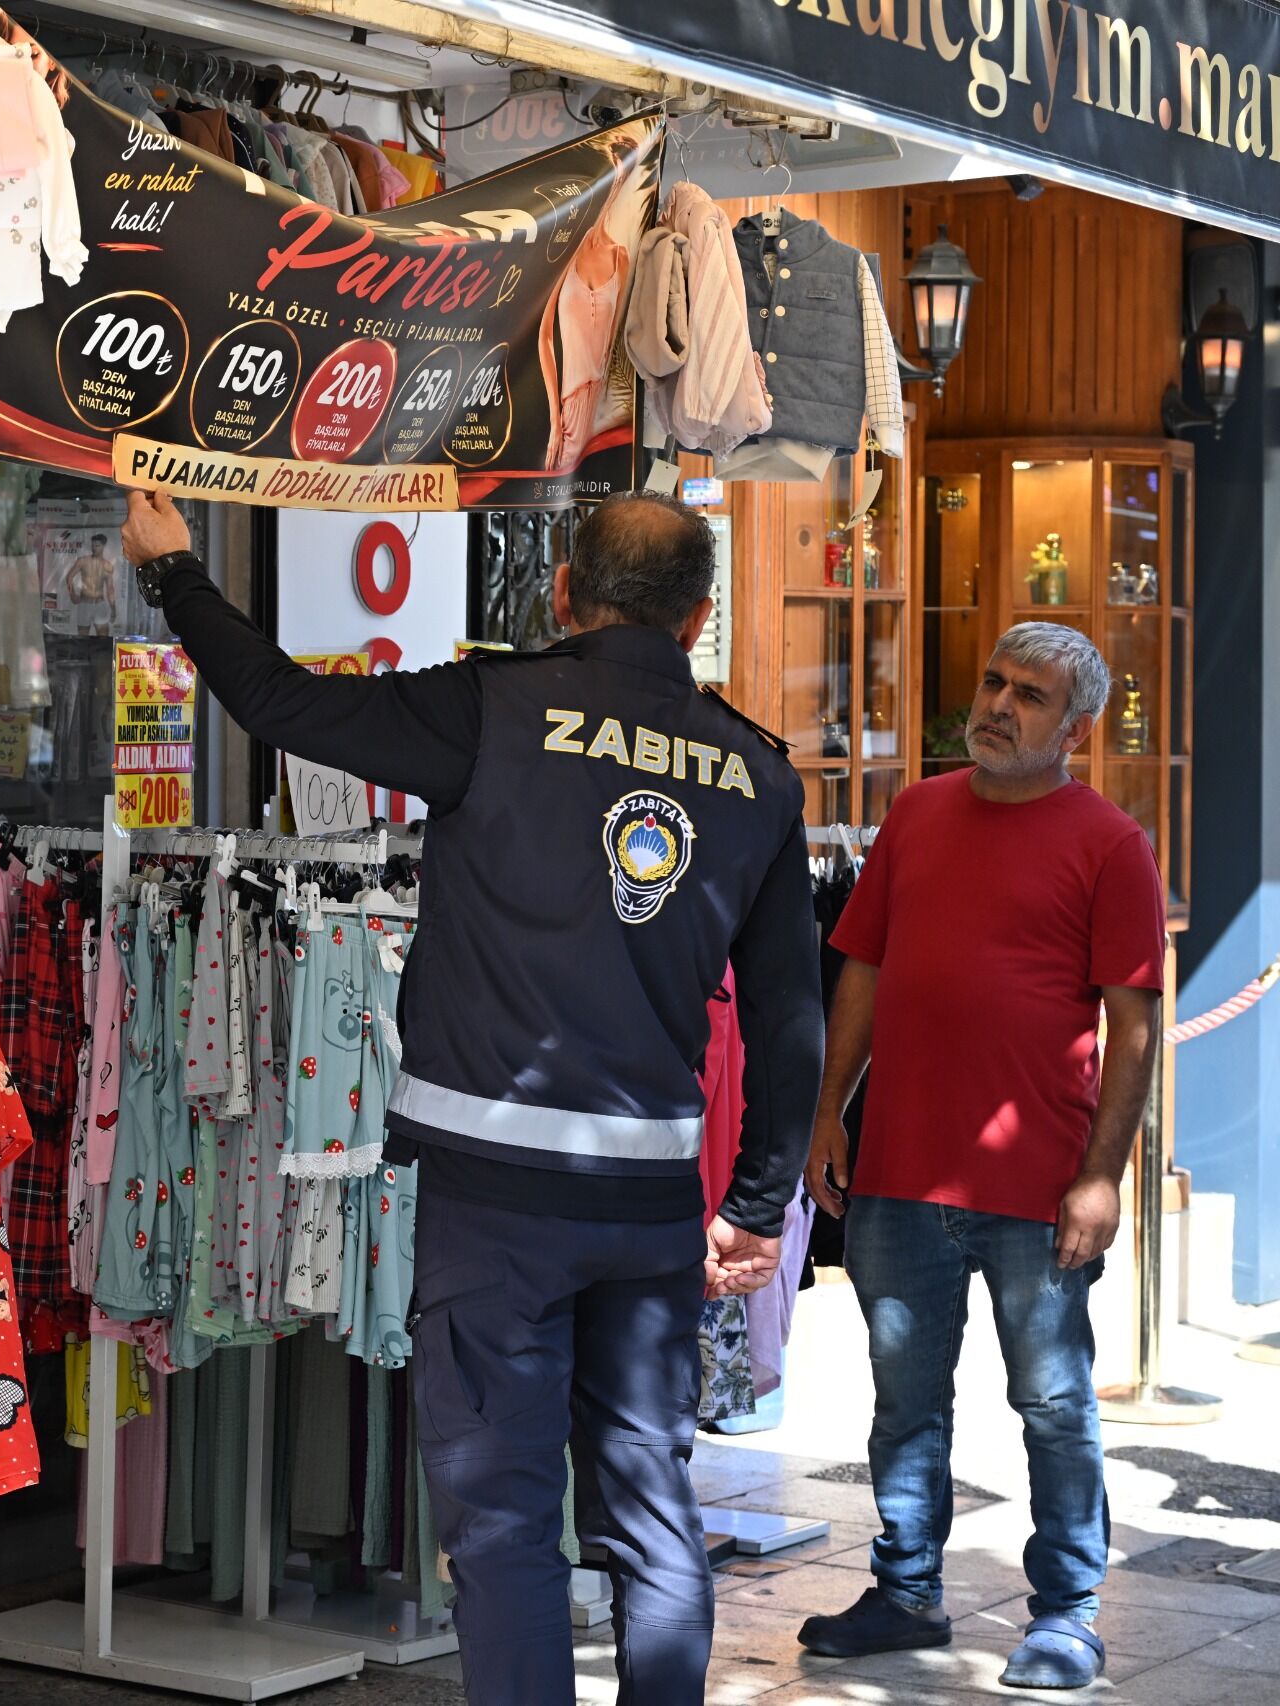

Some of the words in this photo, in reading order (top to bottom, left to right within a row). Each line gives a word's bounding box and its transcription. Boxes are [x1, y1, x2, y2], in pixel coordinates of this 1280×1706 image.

[105, 171, 134, 190] en
[137, 163, 203, 192] rahat
[111, 200, 174, 233] hali!
[256, 203, 503, 314] Partisi
[228, 292, 274, 317] YAZA
[286, 300, 328, 328] ÖZEL
[353, 317, 403, 341] SEÇİLİ
[407, 323, 484, 343] PİJAMALARDA
[81, 313, 173, 376] 100₺
[219, 343, 287, 398] 150₺
[82, 379, 136, 402] BAŞLAYAN
[317, 360, 382, 410] 200₺
[403, 368, 452, 411] 250₺
[78, 393, 131, 417] FİYATLARLA
[214, 410, 257, 426] BAŞLAYAN
[206, 423, 253, 441] FİYATLARLA
[314, 426, 351, 438] BAŞLAYAN
[451, 437, 494, 450] FİYATLARLA
[455, 425, 489, 437] BAŞLAYAN
[306, 438, 346, 452] FİYATLARLA
[131, 447, 260, 494] PİJAMADA
[261, 463, 352, 502] İDDİALI
[348, 469, 445, 504] FİYATLAR!
[120, 654, 155, 669] TUTKU
[161, 705, 182, 722] ESNEK
[118, 725, 138, 742] RAHAT
[147, 725, 168, 742] ASKILI
[170, 724, 190, 741] TAKIM
[117, 746, 154, 771] ALDIN,
[155, 745, 190, 769] ALDIN
[544, 708, 755, 799] ZABITA
[141, 777, 179, 824] 200
[628, 797, 677, 822] ZABITA
